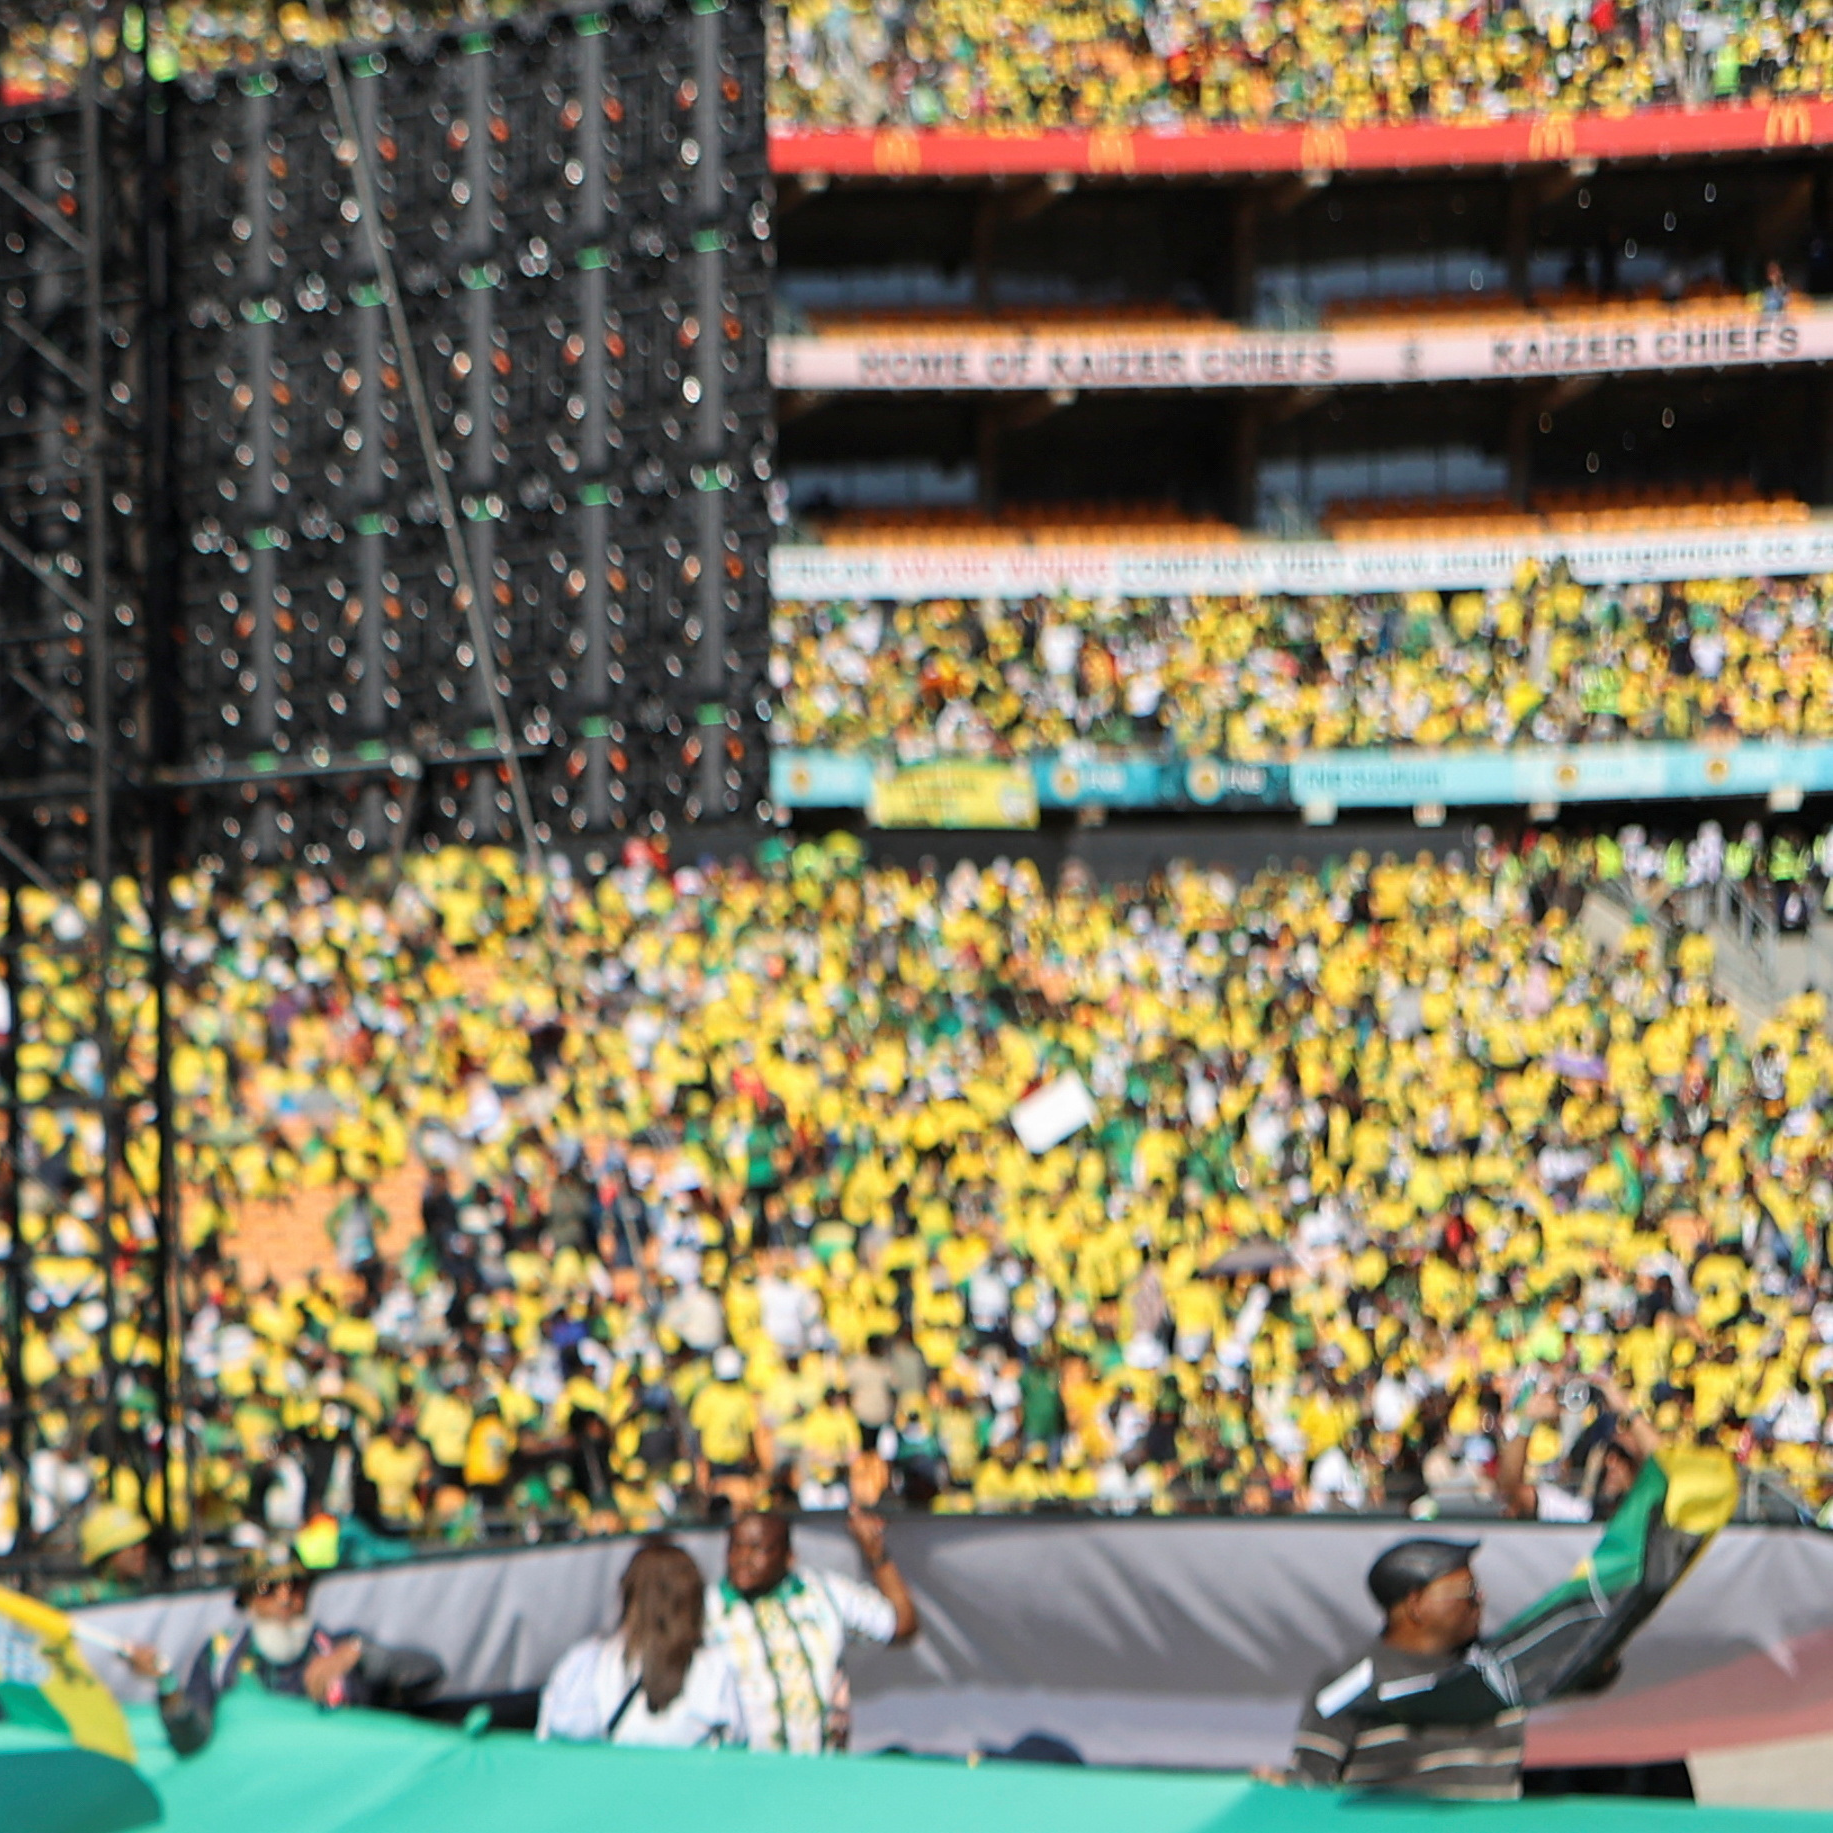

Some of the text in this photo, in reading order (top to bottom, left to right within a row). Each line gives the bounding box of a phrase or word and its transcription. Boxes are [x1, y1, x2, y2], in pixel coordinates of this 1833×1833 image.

[859, 343, 1341, 385] HOME OF KAIZER CHIEFS
[1492, 325, 1802, 373] KAIZER CHIEFS
